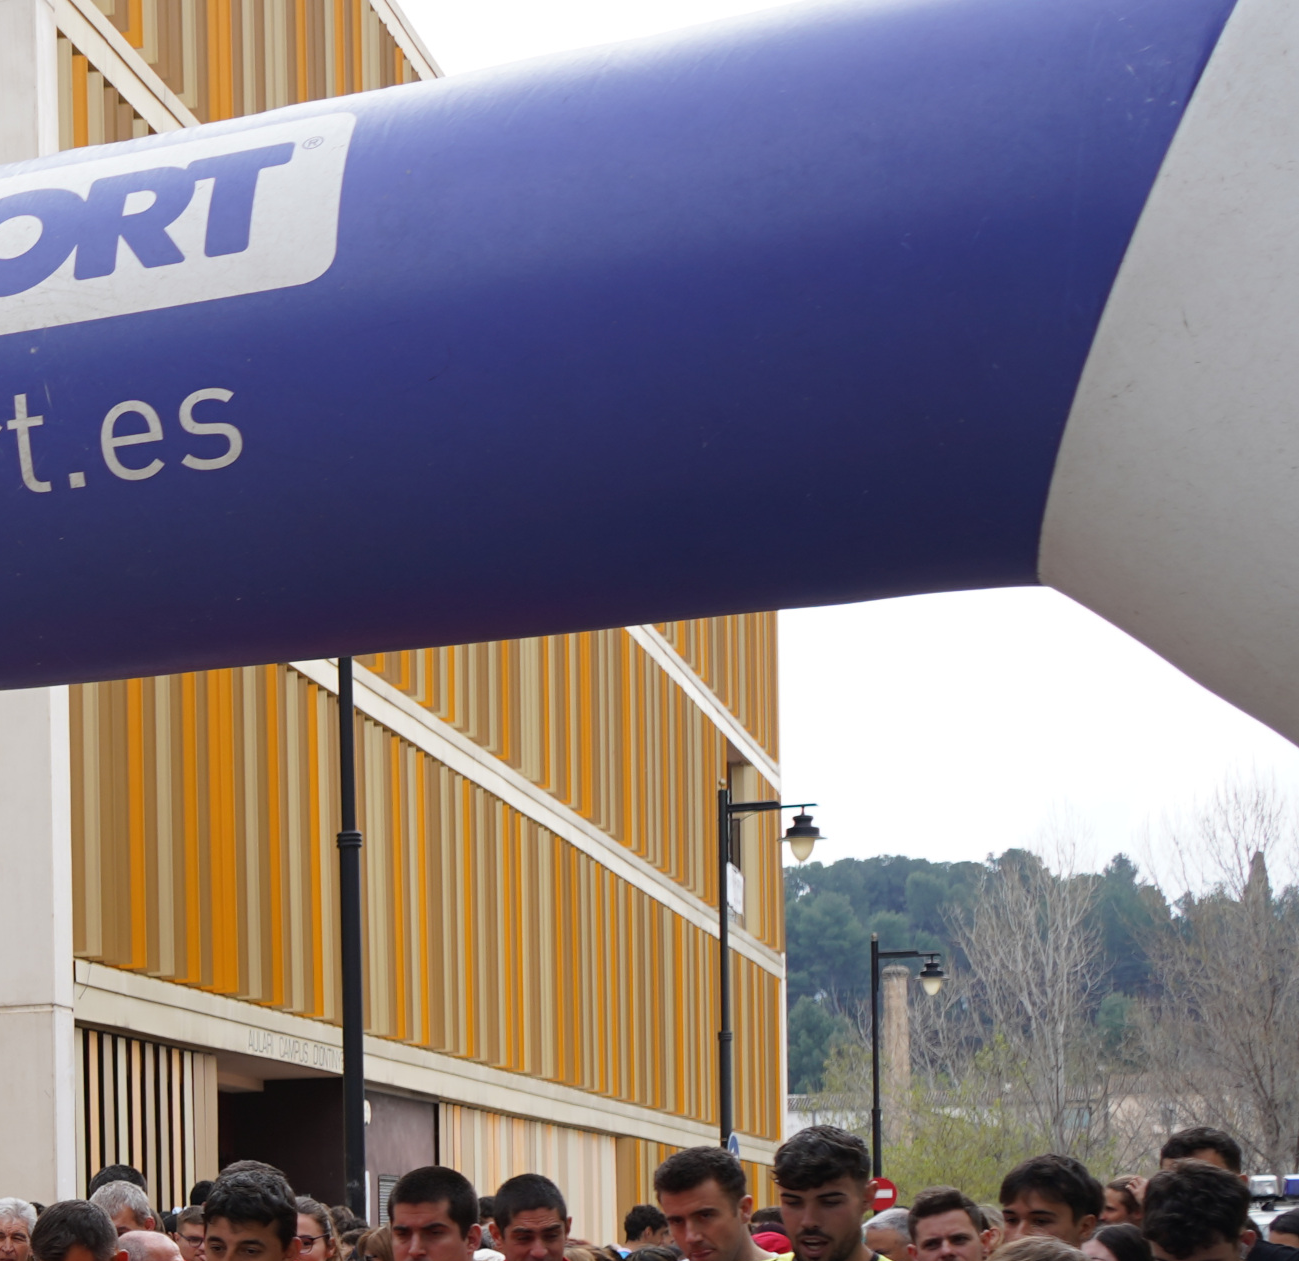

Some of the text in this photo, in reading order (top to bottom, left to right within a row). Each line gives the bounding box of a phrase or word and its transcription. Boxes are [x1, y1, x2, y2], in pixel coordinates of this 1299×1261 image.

[248, 1029, 344, 1070] AULARI CAMPUS D'ONTINY
